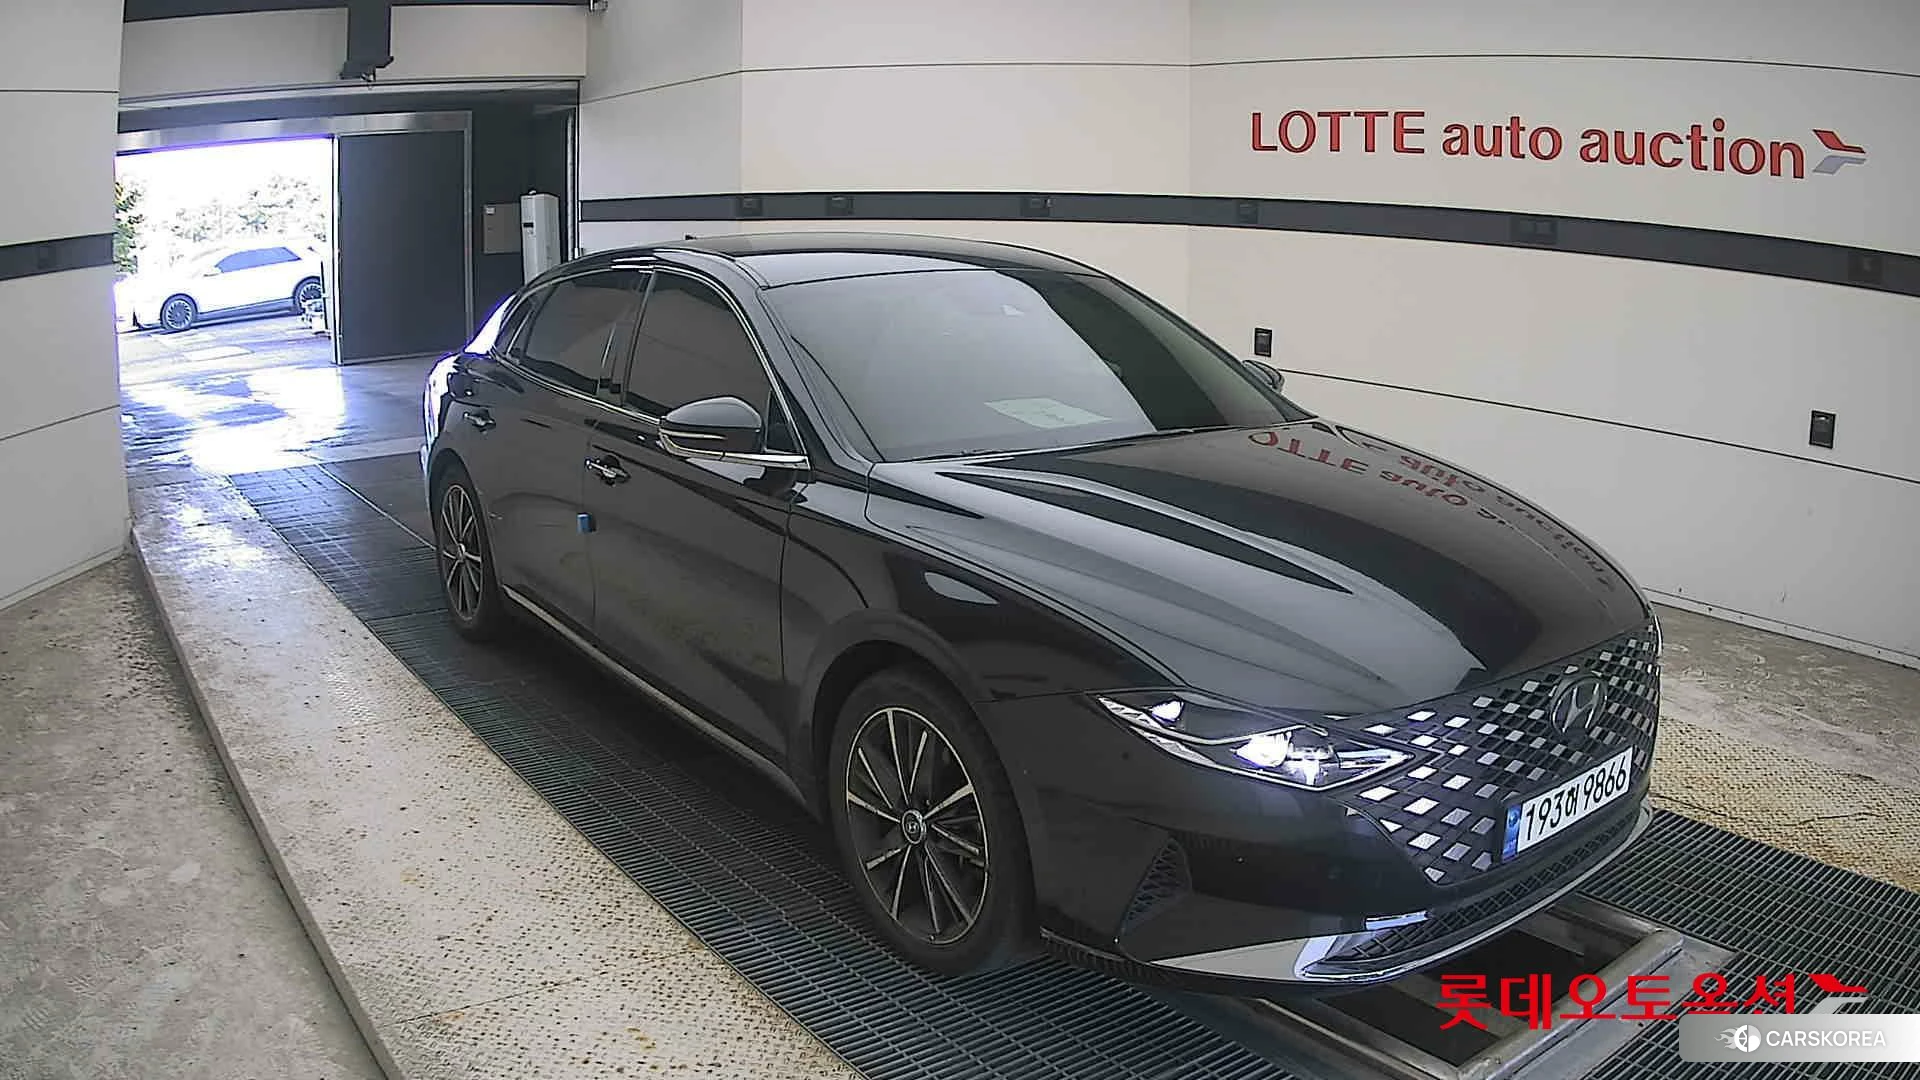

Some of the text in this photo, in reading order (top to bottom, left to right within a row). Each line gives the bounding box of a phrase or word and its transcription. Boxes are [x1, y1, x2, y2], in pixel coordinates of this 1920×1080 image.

[1251, 111, 1806, 179] LOTTE auto auction
[1583, 755, 1627, 811] 9866
